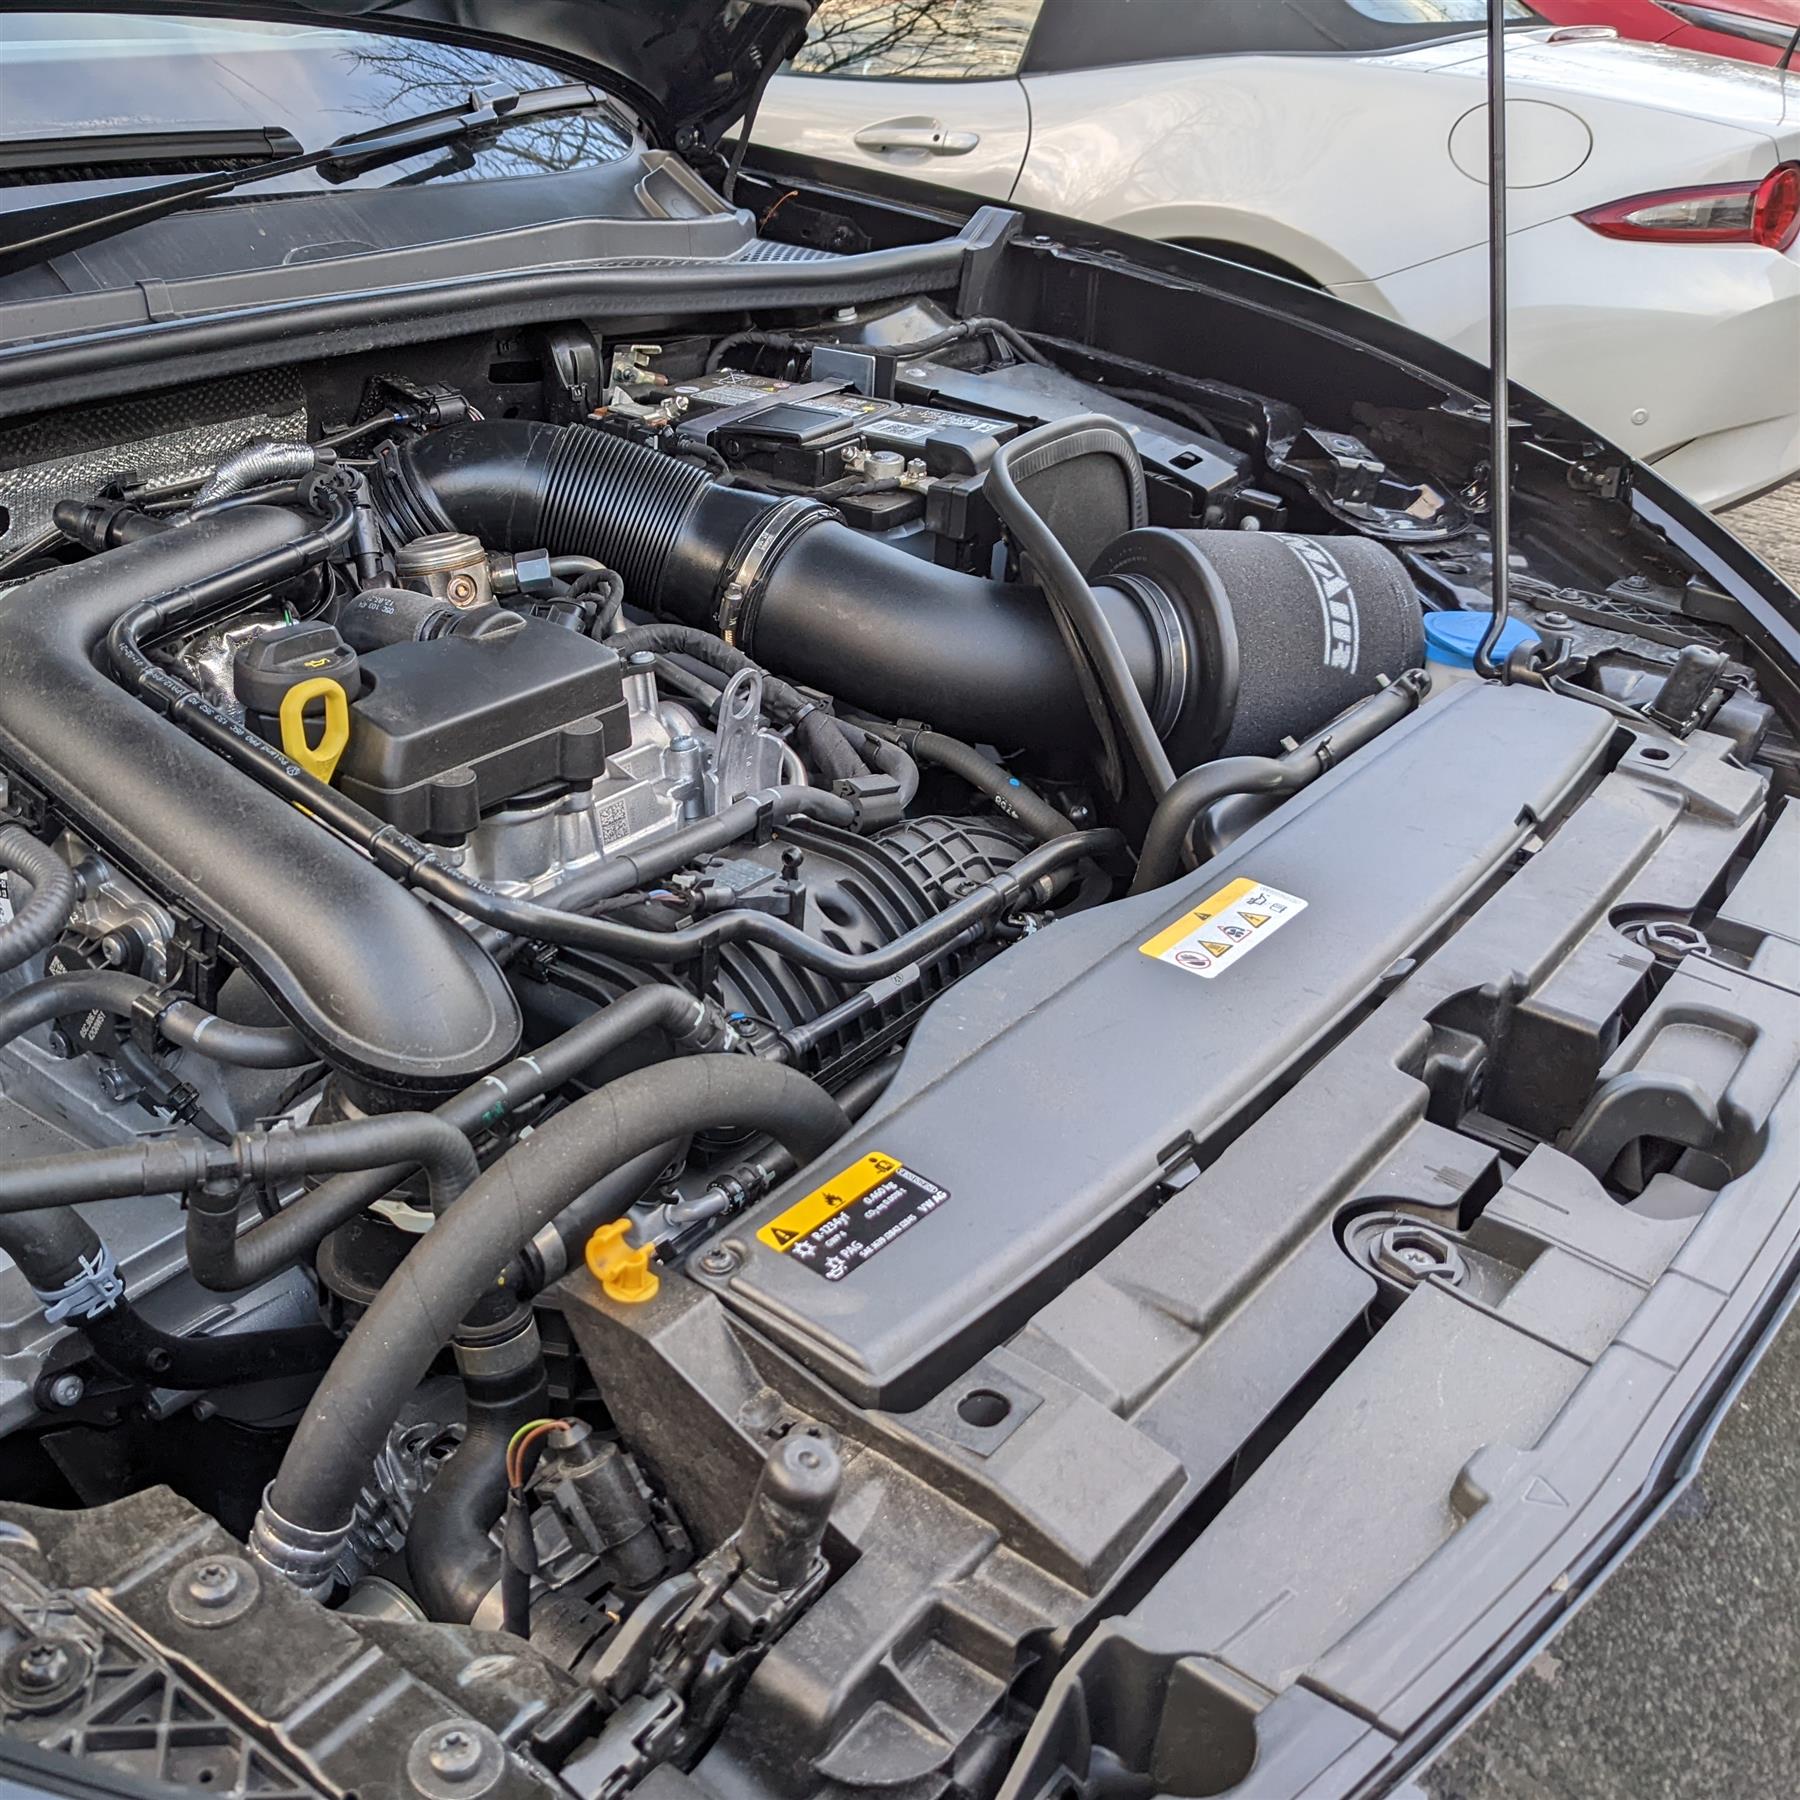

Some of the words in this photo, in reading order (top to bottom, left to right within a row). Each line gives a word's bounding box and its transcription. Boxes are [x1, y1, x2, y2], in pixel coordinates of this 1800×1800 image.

[881, 1181, 898, 1193] kg
[917, 1197, 936, 1212] VW
[932, 1190, 948, 1203] AG
[811, 1211, 850, 1241] R-1234yf
[839, 1240, 863, 1259] PAG
